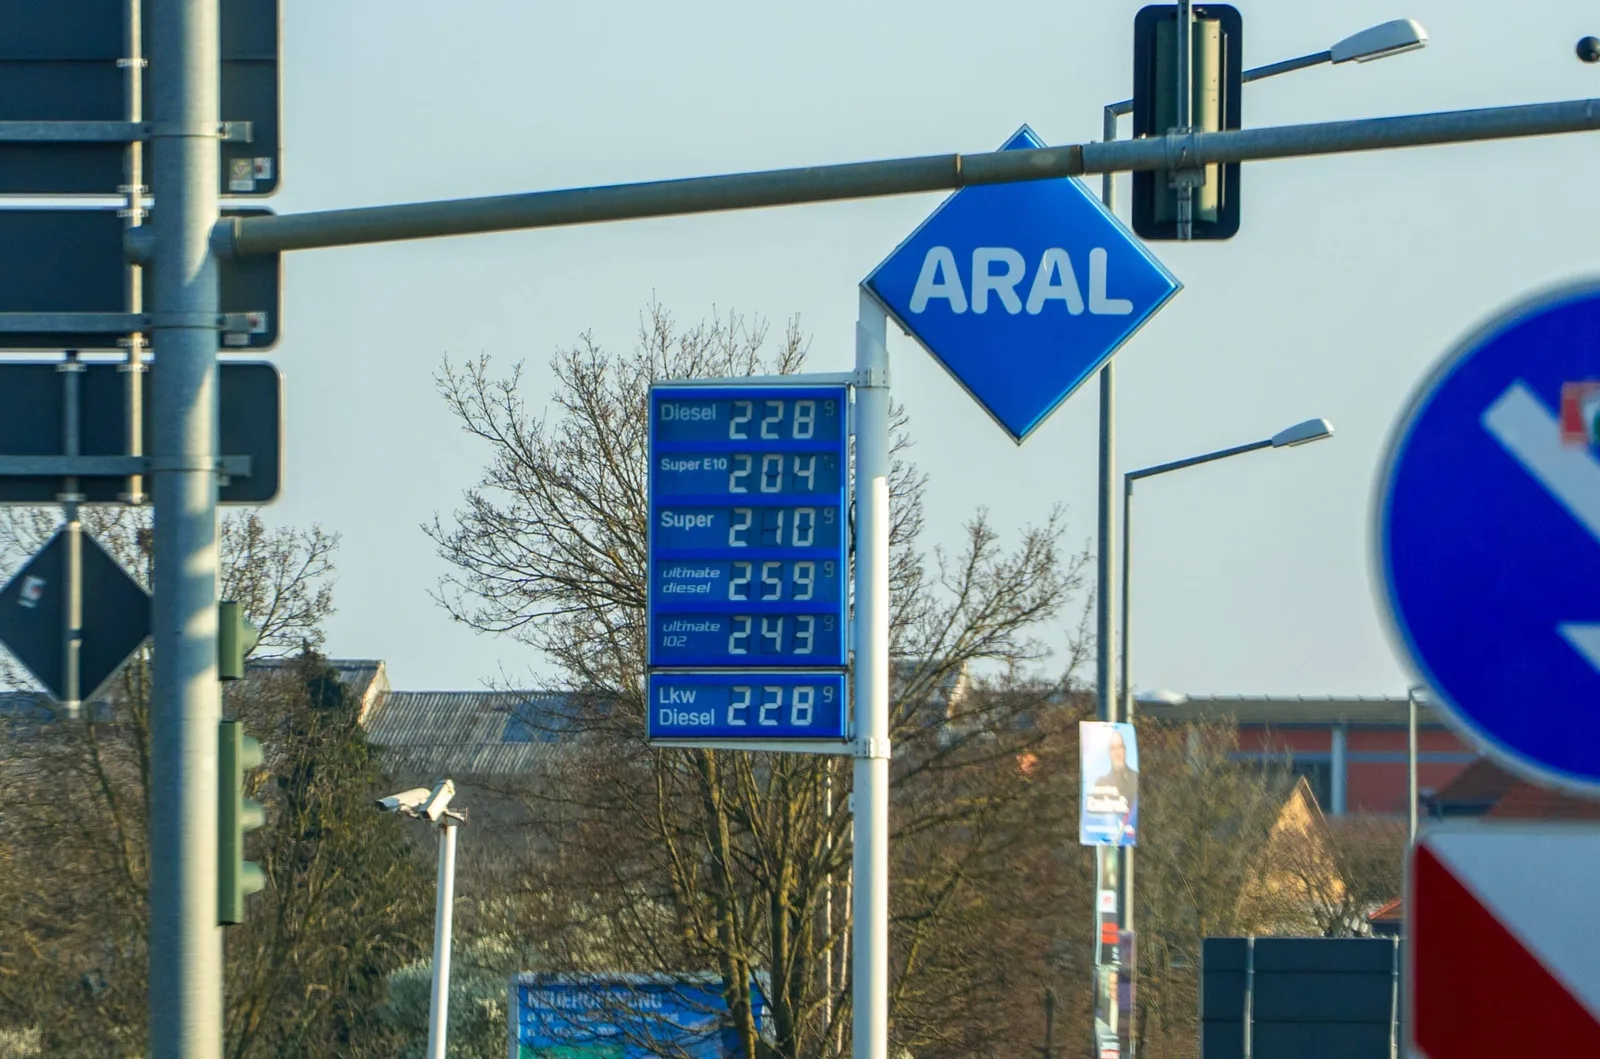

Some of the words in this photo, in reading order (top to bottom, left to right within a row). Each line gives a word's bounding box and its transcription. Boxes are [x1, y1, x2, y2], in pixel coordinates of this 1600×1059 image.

[909, 245, 1134, 315] ARAL
[660, 403, 716, 421] Diesel
[729, 400, 816, 440] 228
[660, 458, 701, 473] Super
[703, 458, 727, 471] E10
[729, 454, 816, 493] 204
[660, 511, 714, 531] Super
[728, 507, 816, 547] 210
[662, 566, 721, 578] ultimate
[728, 561, 816, 601] 259
[662, 582, 711, 594] diesel
[662, 620, 721, 632] ultimate
[728, 615, 815, 655] 243
[662, 636, 687, 647] 102
[659, 687, 697, 704] Lkw
[727, 686, 815, 726] 228
[659, 708, 715, 726] Diesel
